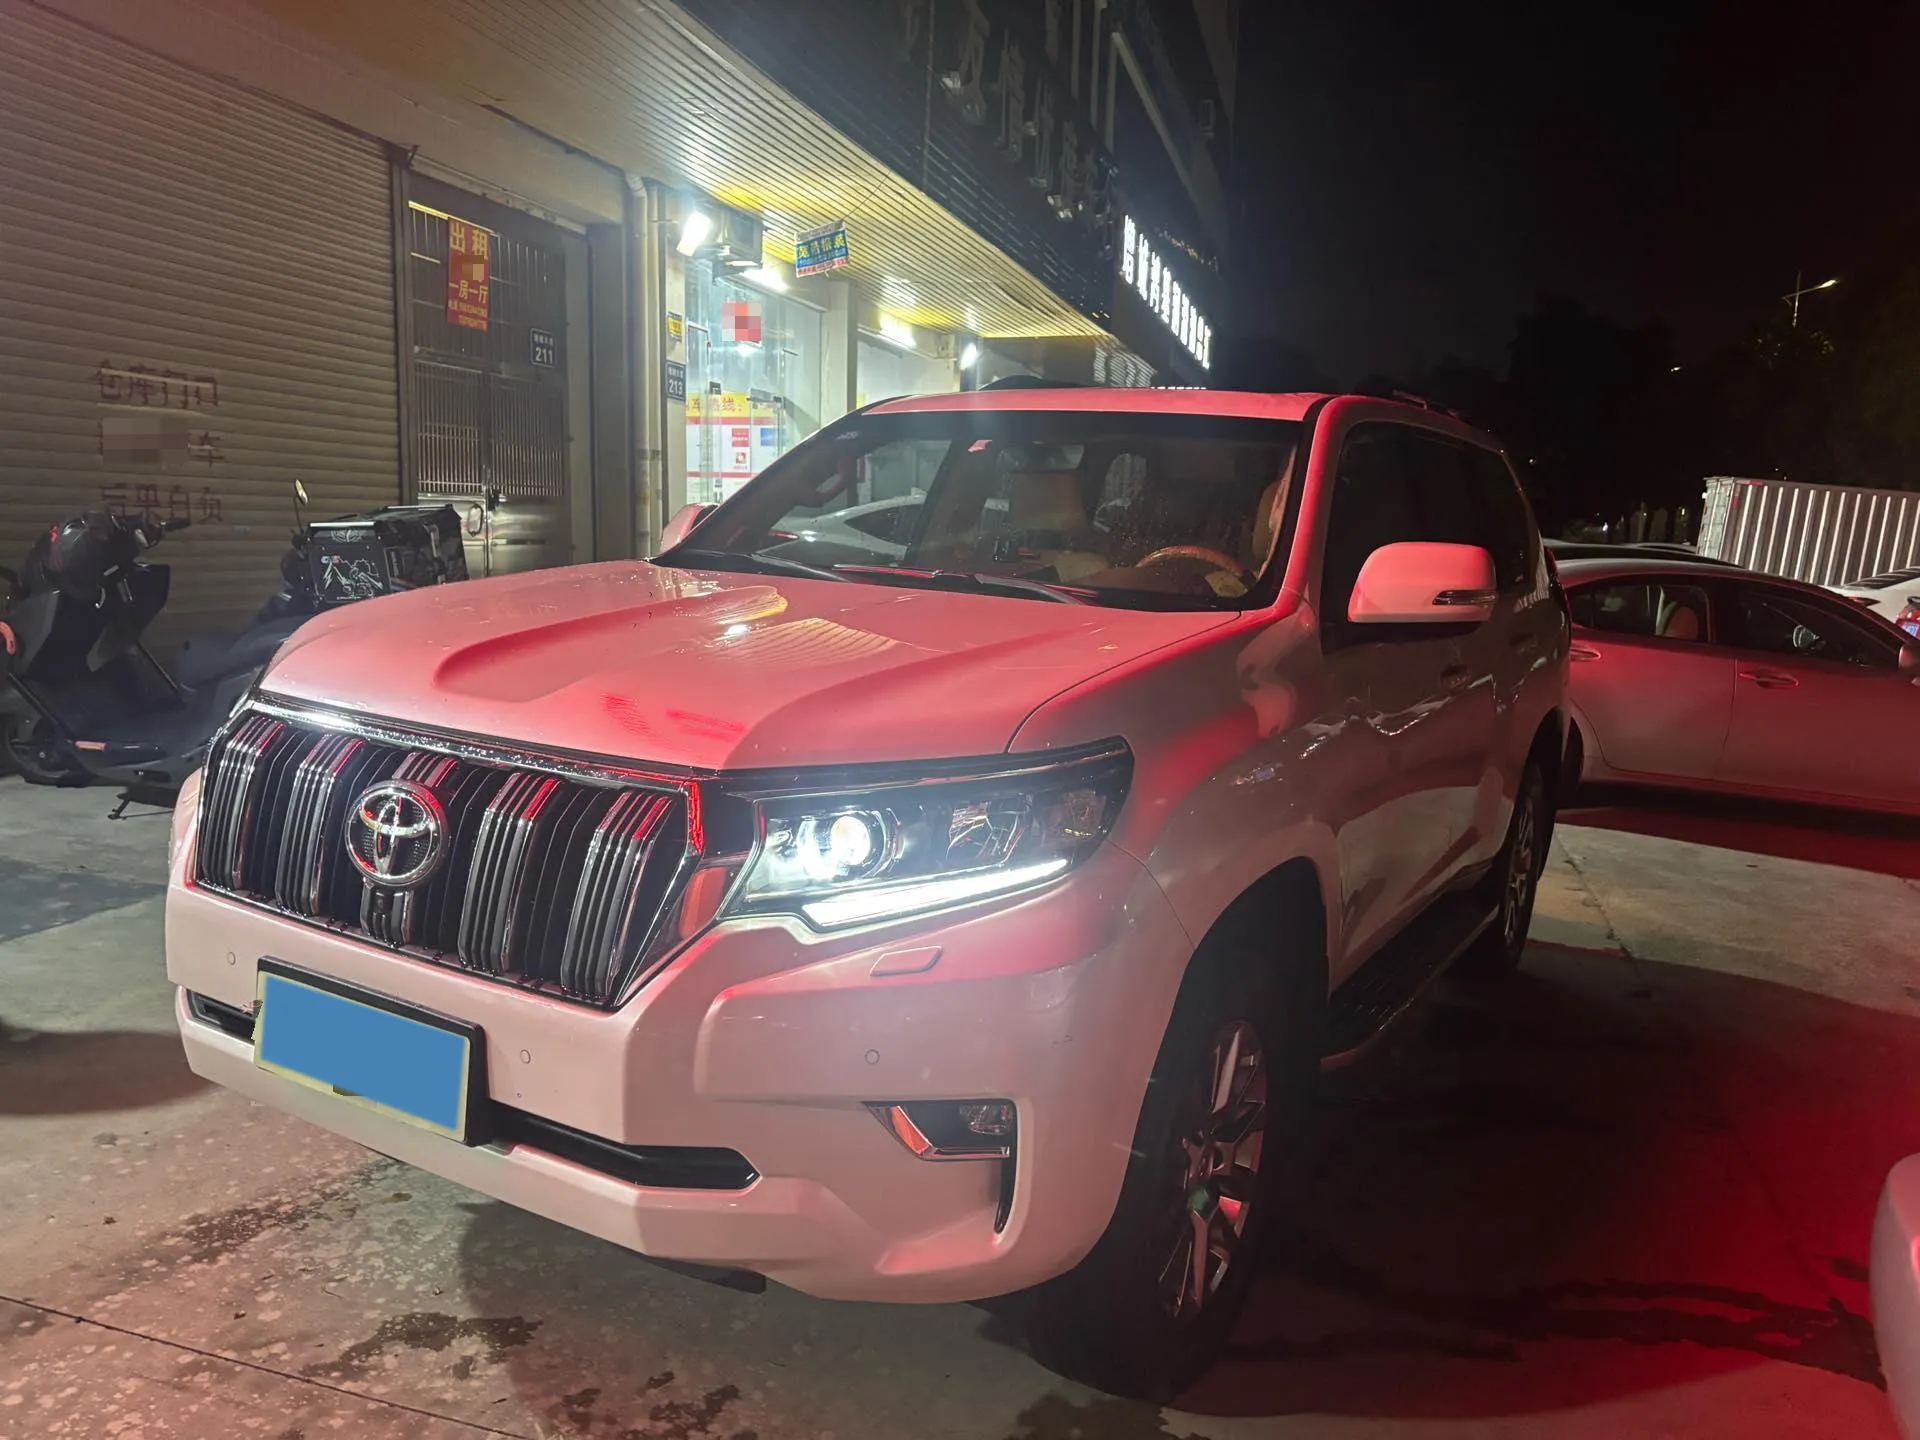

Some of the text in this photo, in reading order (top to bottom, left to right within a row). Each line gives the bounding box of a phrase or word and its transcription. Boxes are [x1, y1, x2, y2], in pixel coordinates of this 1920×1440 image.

[449, 221, 489, 260] 出租
[449, 280, 489, 304] 一房一厅
[535, 346, 553, 364] 211
[668, 379, 684, 395] 213
